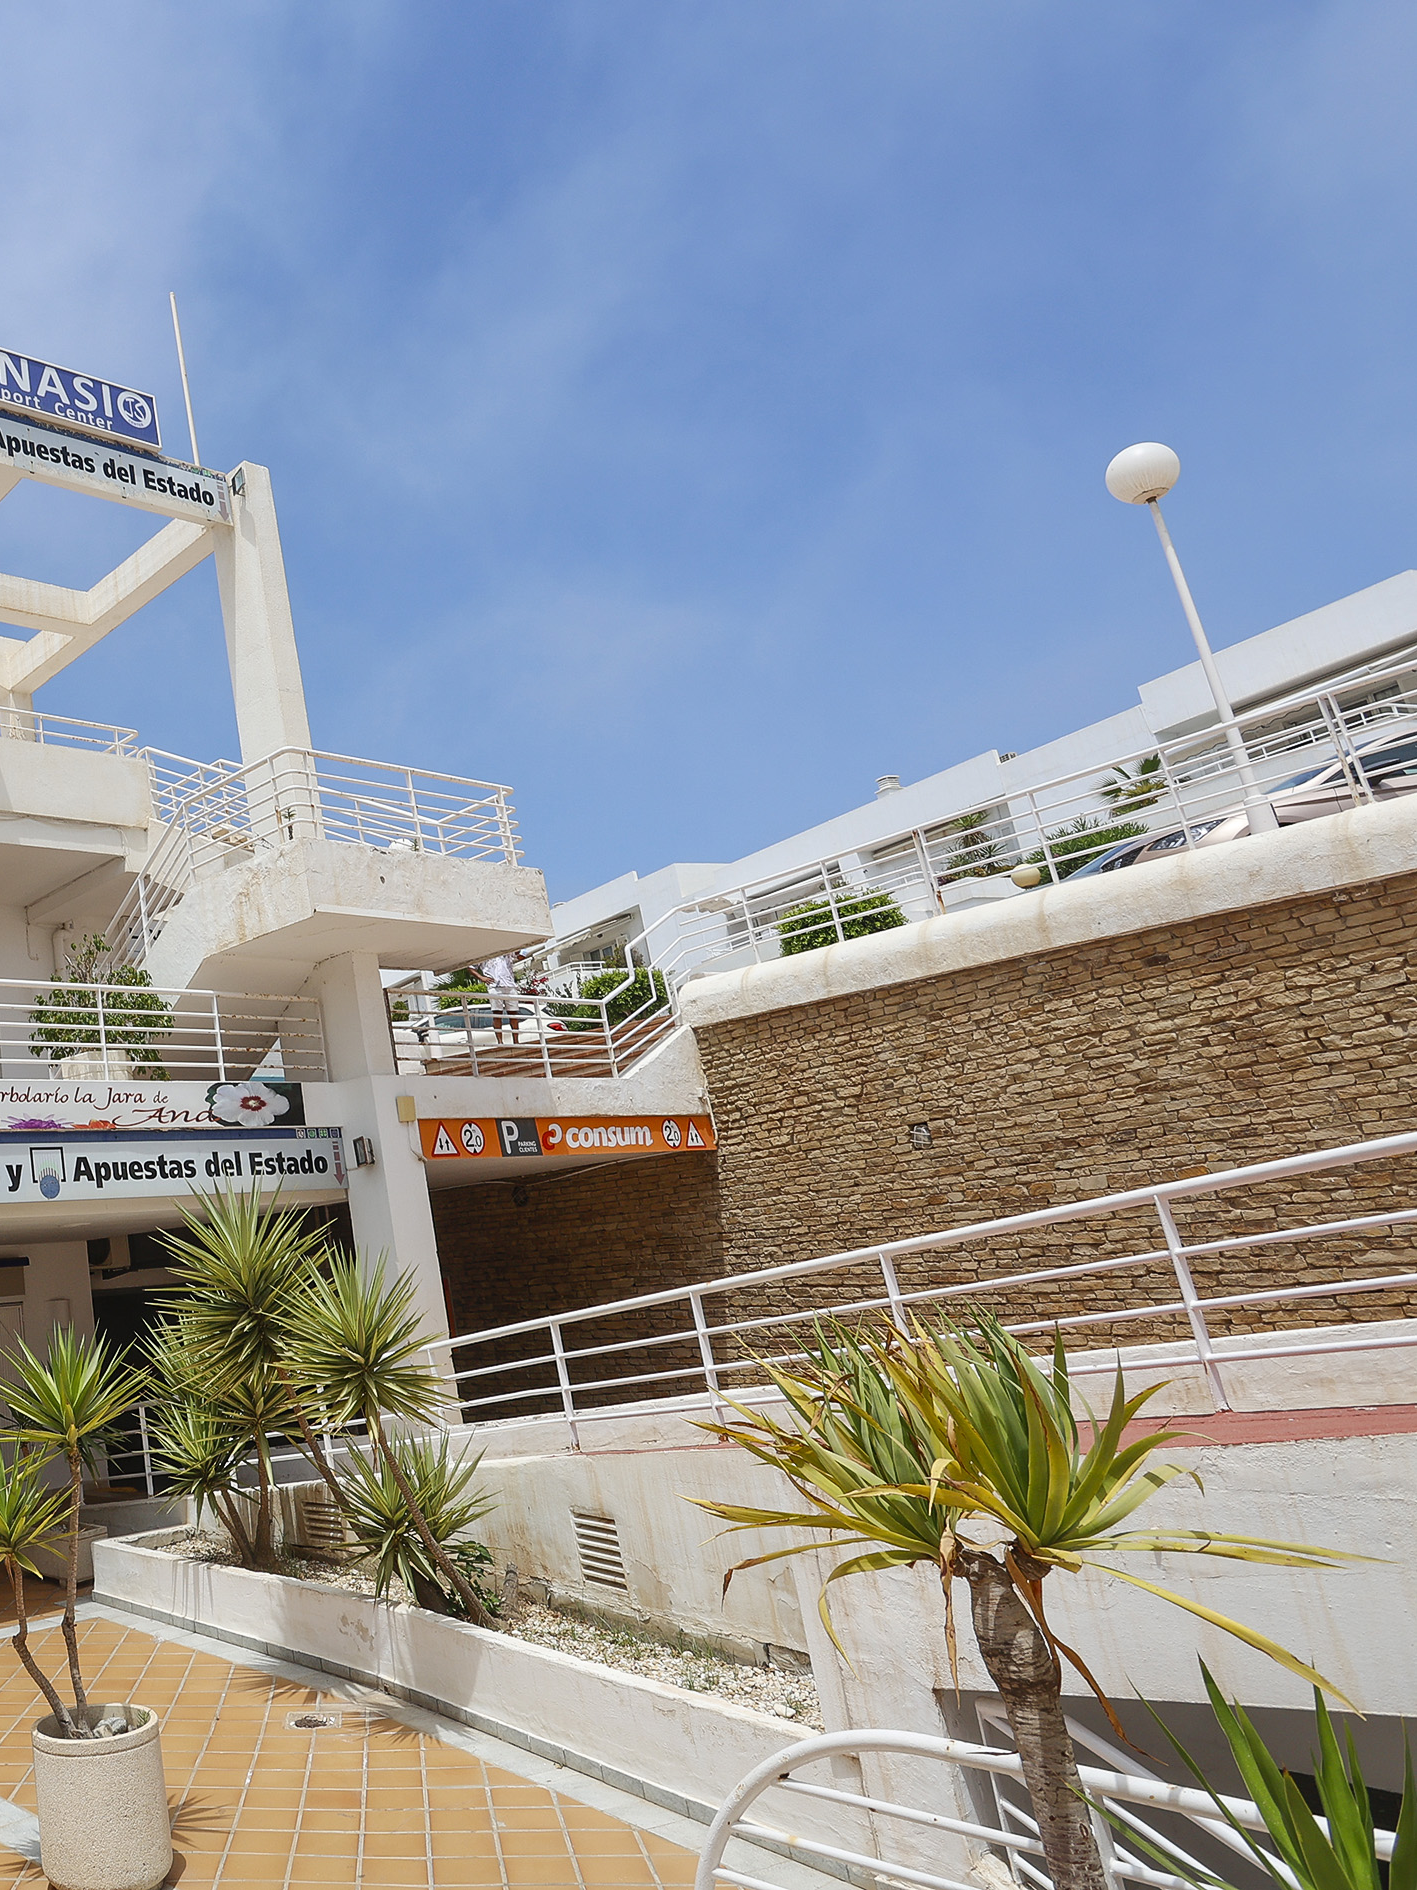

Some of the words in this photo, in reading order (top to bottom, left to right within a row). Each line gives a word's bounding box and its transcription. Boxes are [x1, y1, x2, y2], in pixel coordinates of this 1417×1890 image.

[54, 403, 113, 431] Center
[103, 458, 136, 485] del
[142, 468, 214, 507] Estado
[74, 1086, 95, 1104] la
[93, 1087, 146, 1110] Jara
[153, 1090, 169, 1104] de
[565, 1126, 654, 1148] consum
[5, 1164, 23, 1192] y
[73, 1153, 197, 1189] Apuestas
[205, 1151, 243, 1178] del
[248, 1149, 329, 1177] Estado
